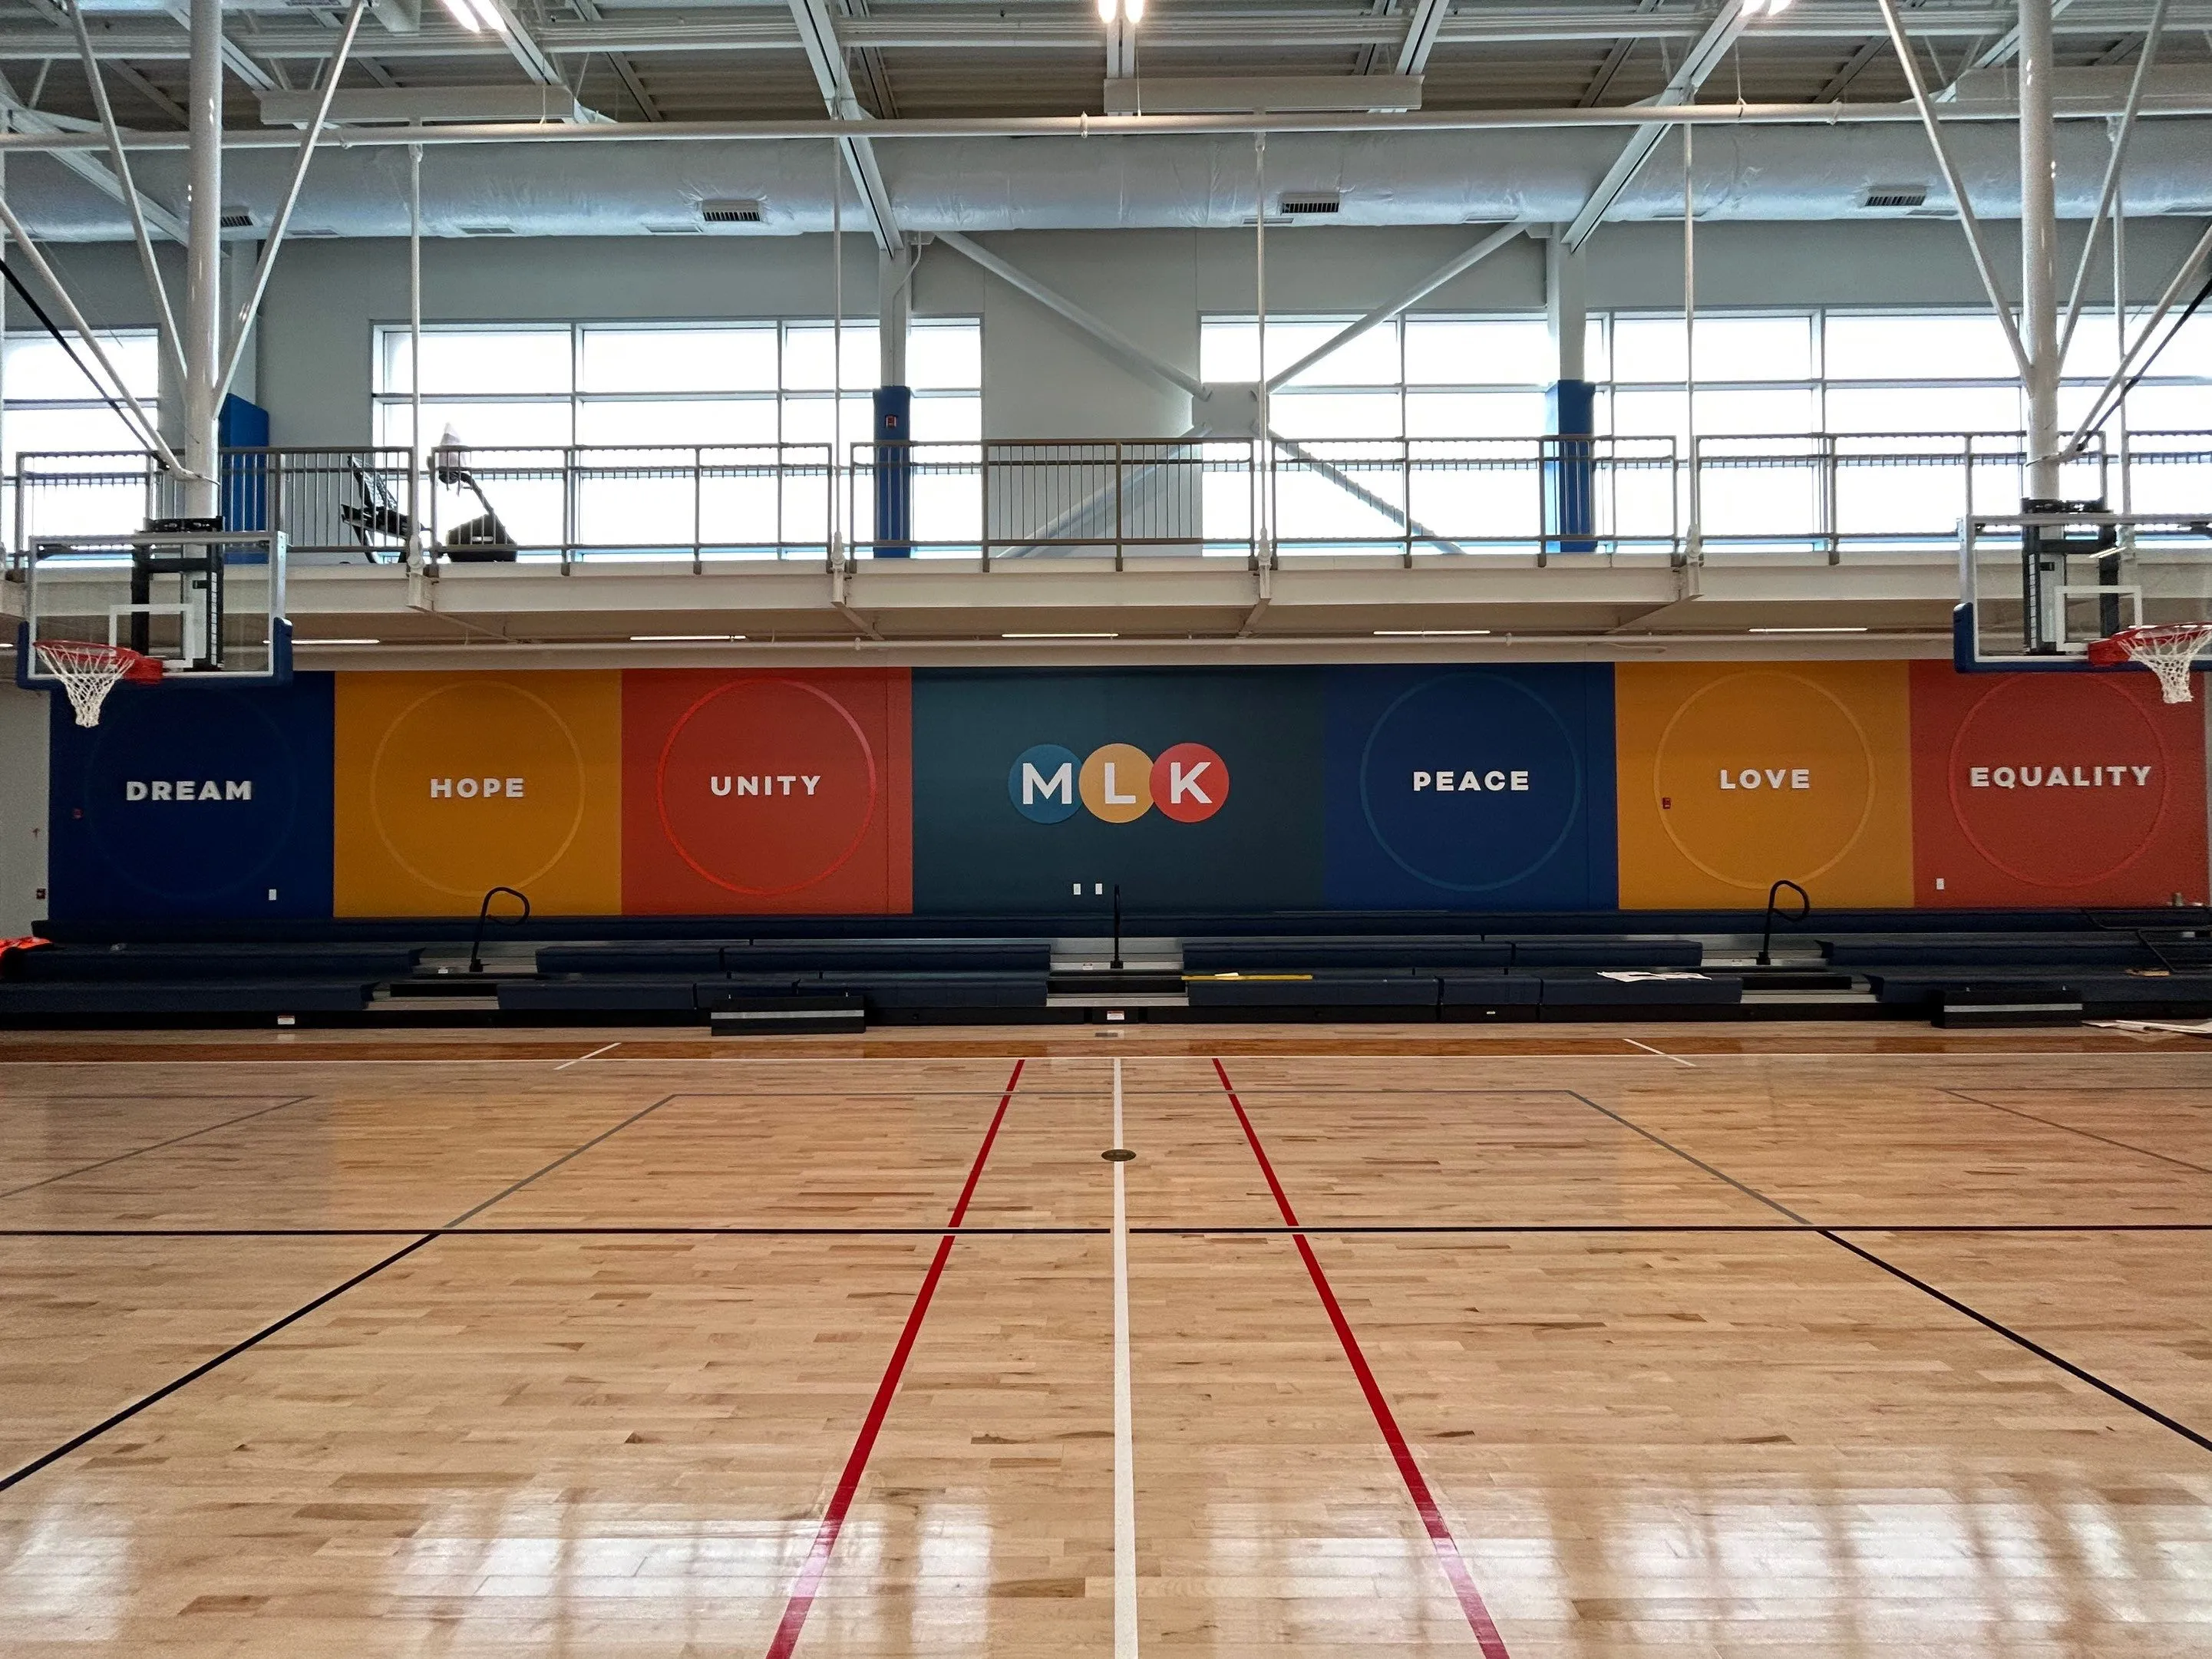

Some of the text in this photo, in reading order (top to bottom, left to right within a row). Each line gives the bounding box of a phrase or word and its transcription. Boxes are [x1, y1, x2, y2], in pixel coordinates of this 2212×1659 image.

[430, 777, 523, 798] HOPE
[710, 775, 821, 797] UNITY
[1022, 762, 1213, 805] MLK
[1413, 770, 1529, 792] PEACE
[1719, 769, 1810, 790] LOVE
[1970, 766, 2152, 789] EQUALITY
[126, 780, 251, 801] DREAM
